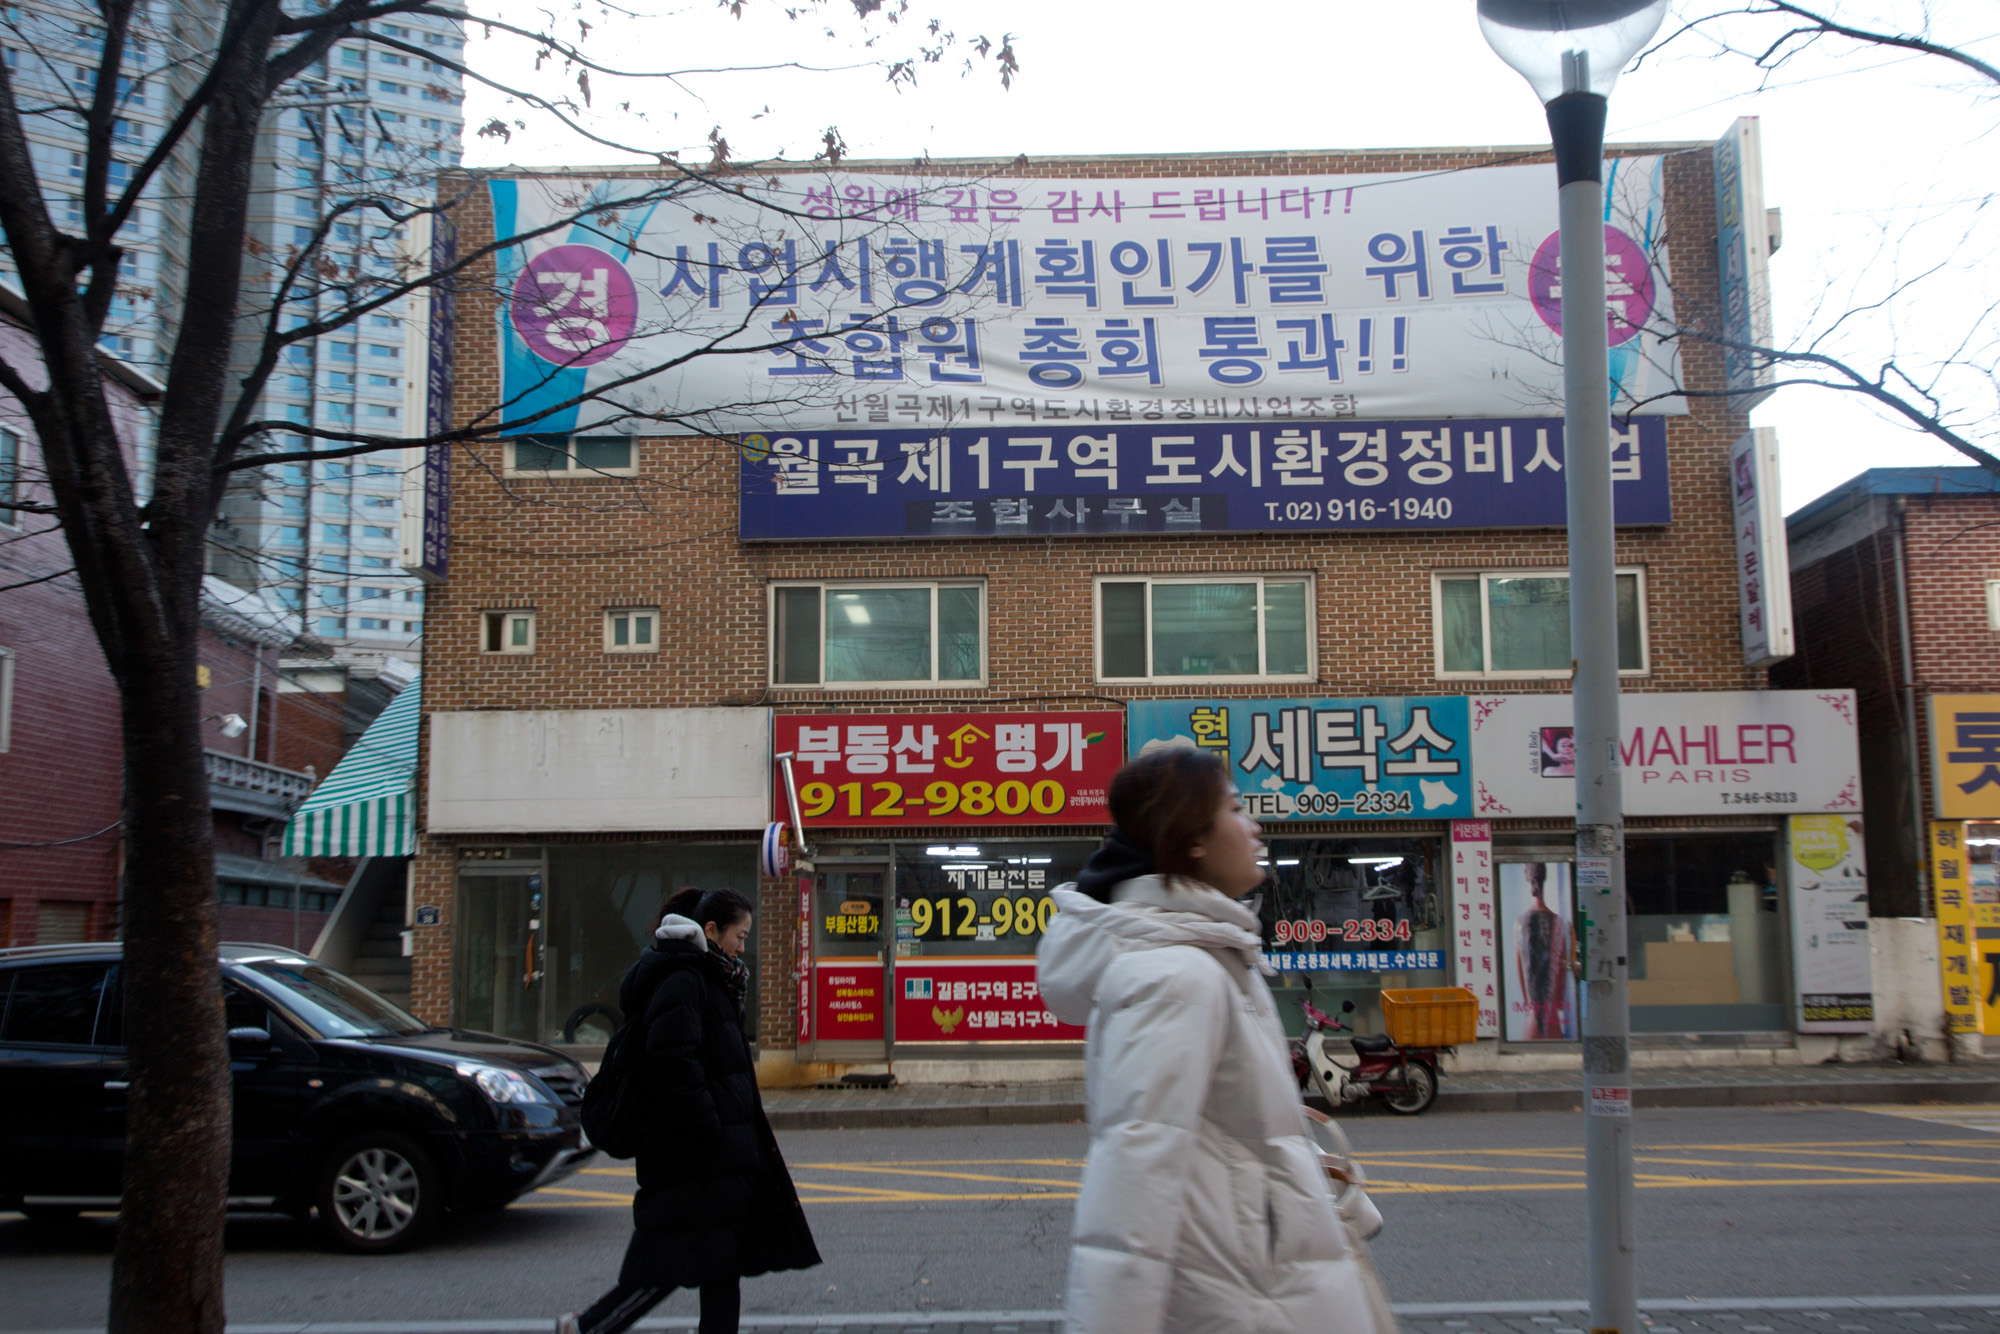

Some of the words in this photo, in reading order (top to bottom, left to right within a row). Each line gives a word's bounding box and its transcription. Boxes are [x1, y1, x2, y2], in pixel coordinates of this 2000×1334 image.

[801, 184, 919, 222] 성원에
[946, 187, 1023, 223] 깊은
[1046, 189, 1126, 223] 감사
[1147, 186, 1356, 222] 드립니다!!
[1365, 225, 1510, 300] 위한
[535, 268, 611, 353] 경
[767, 312, 987, 386] 조합원
[1019, 316, 1165, 390] 총회
[1199, 312, 1411, 387] 통과!!
[932, 497, 1201, 525] 조합사무실
[1327, 498, 1453, 522] 916-1940
[797, 724, 940, 775] 부동산
[994, 723, 1089, 773] 명가
[1241, 706, 1459, 782] 세탁소
[1620, 723, 1798, 768] MAHLER
[1641, 768, 1752, 785] PARIS
[799, 780, 1067, 818] 912-9800
[1243, 795, 1290, 815] TEL
[1296, 791, 1413, 815] 909-2334
[948, 869, 1046, 891] 재개발전문
[825, 914, 879, 934] 부동산명가
[1275, 919, 1412, 942] 909-2334
[936, 981, 1008, 1002] 길음1구역
[966, 1010, 1058, 1029] 신월곡1구역
